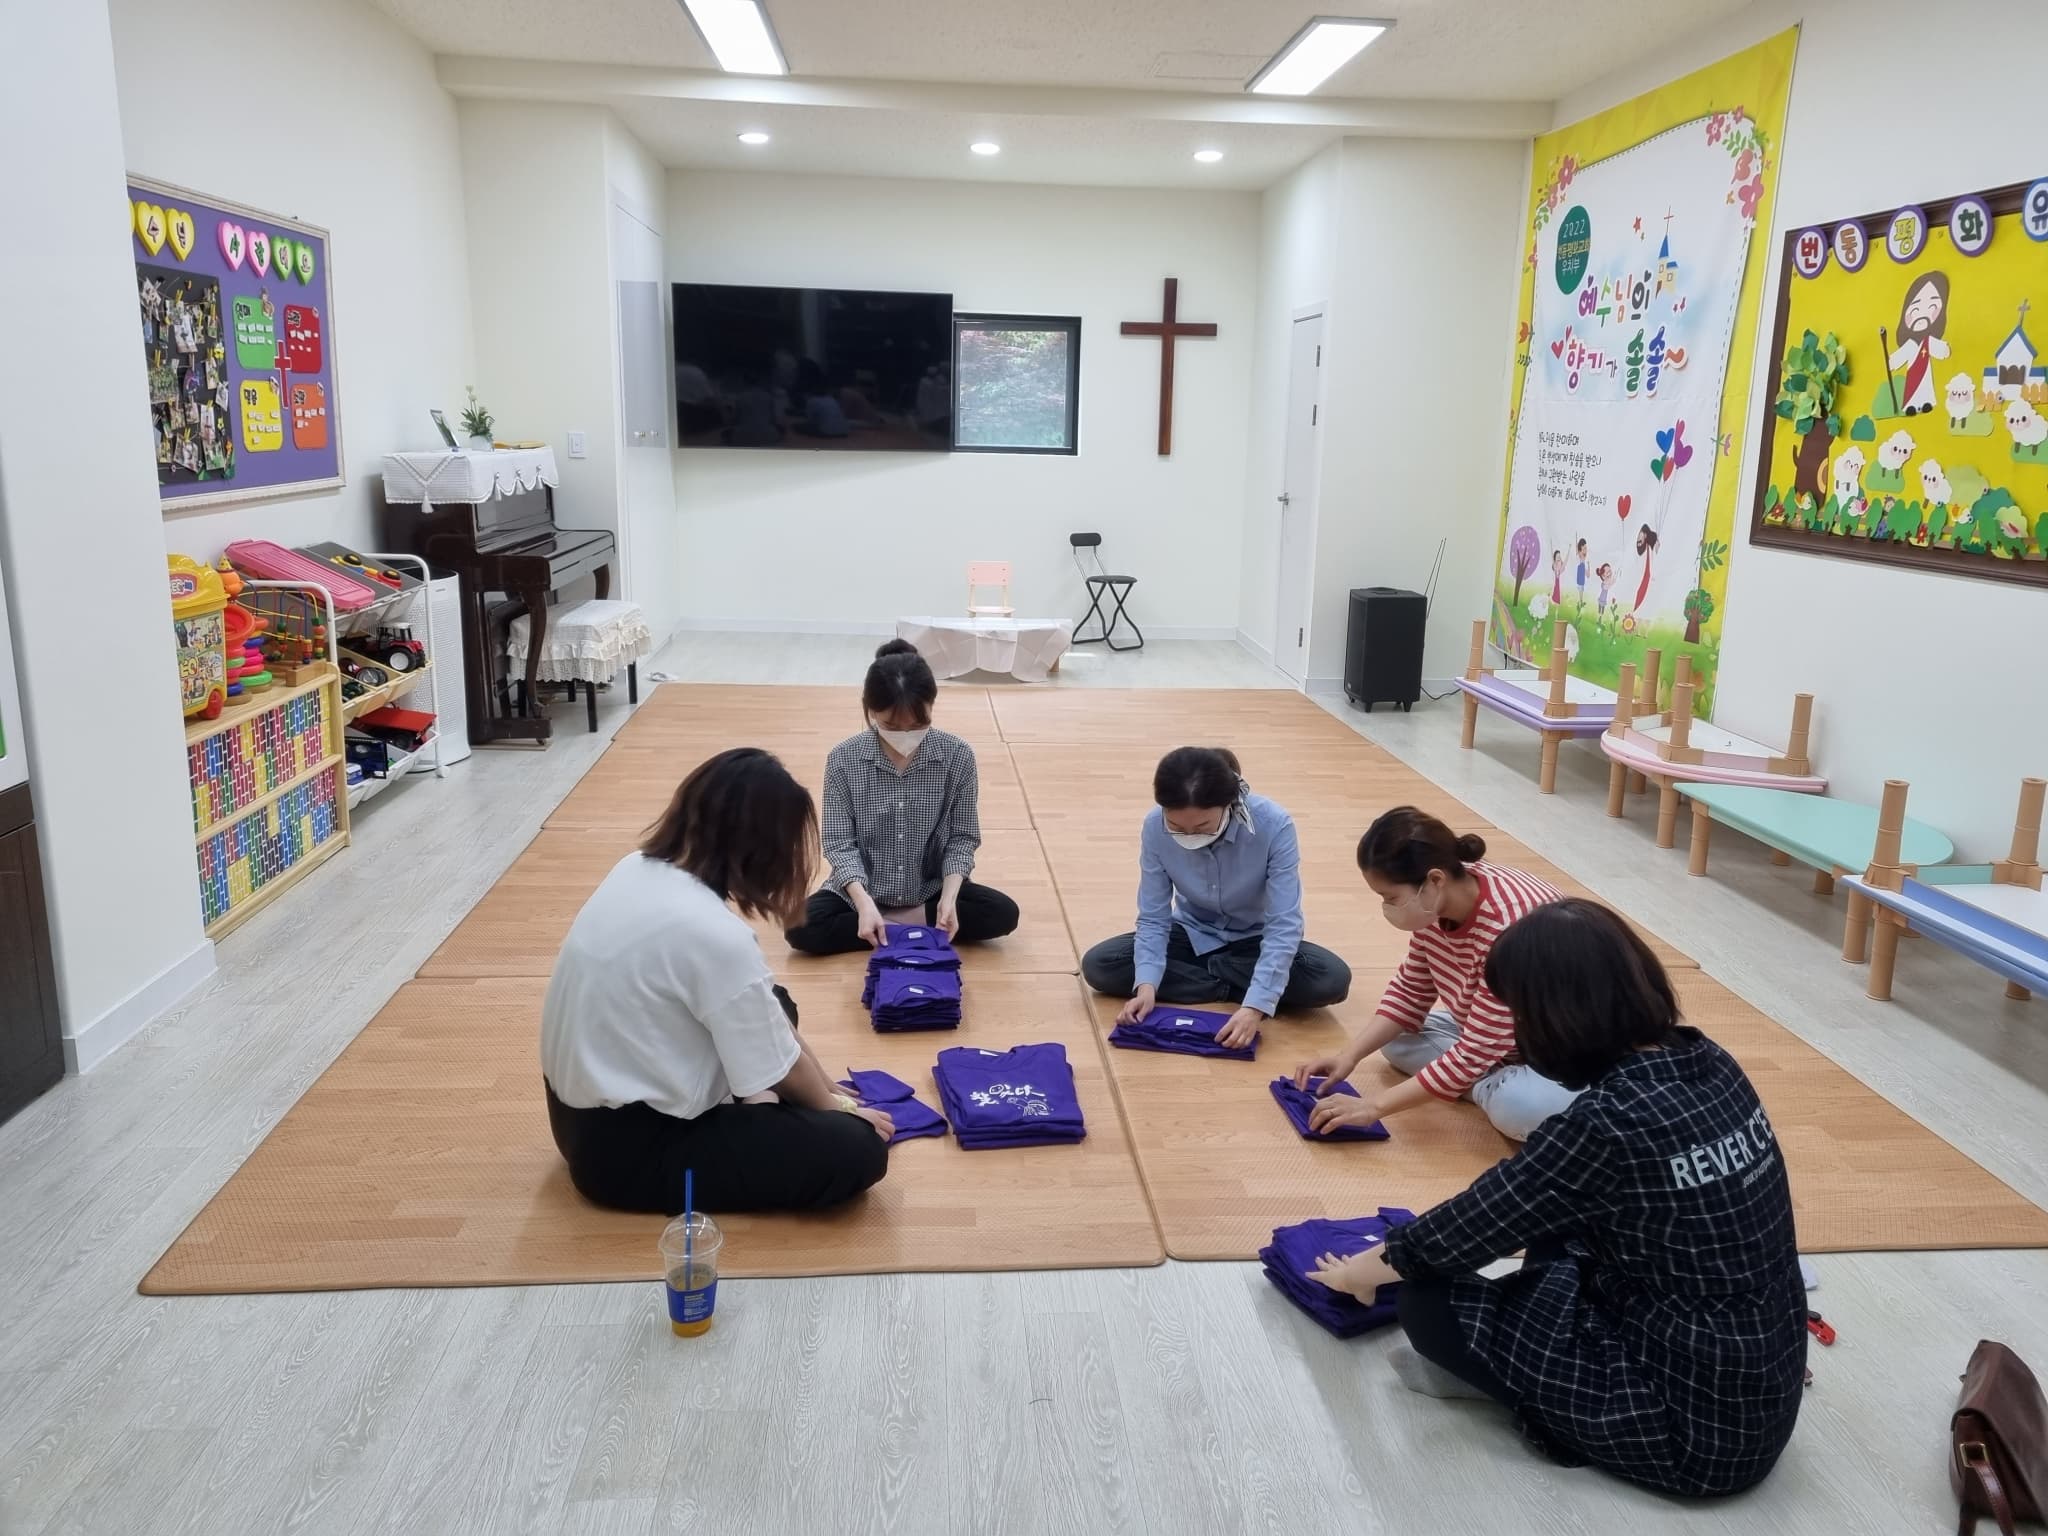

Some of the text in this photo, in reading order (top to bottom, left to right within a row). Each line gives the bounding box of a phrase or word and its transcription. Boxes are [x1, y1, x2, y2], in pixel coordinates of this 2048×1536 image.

[1562, 218, 1586, 239] 2022
[1578, 271, 1652, 328] 예수님의
[1564, 337, 1618, 391] 향기가
[1749, 1105, 1773, 1150] C'E
